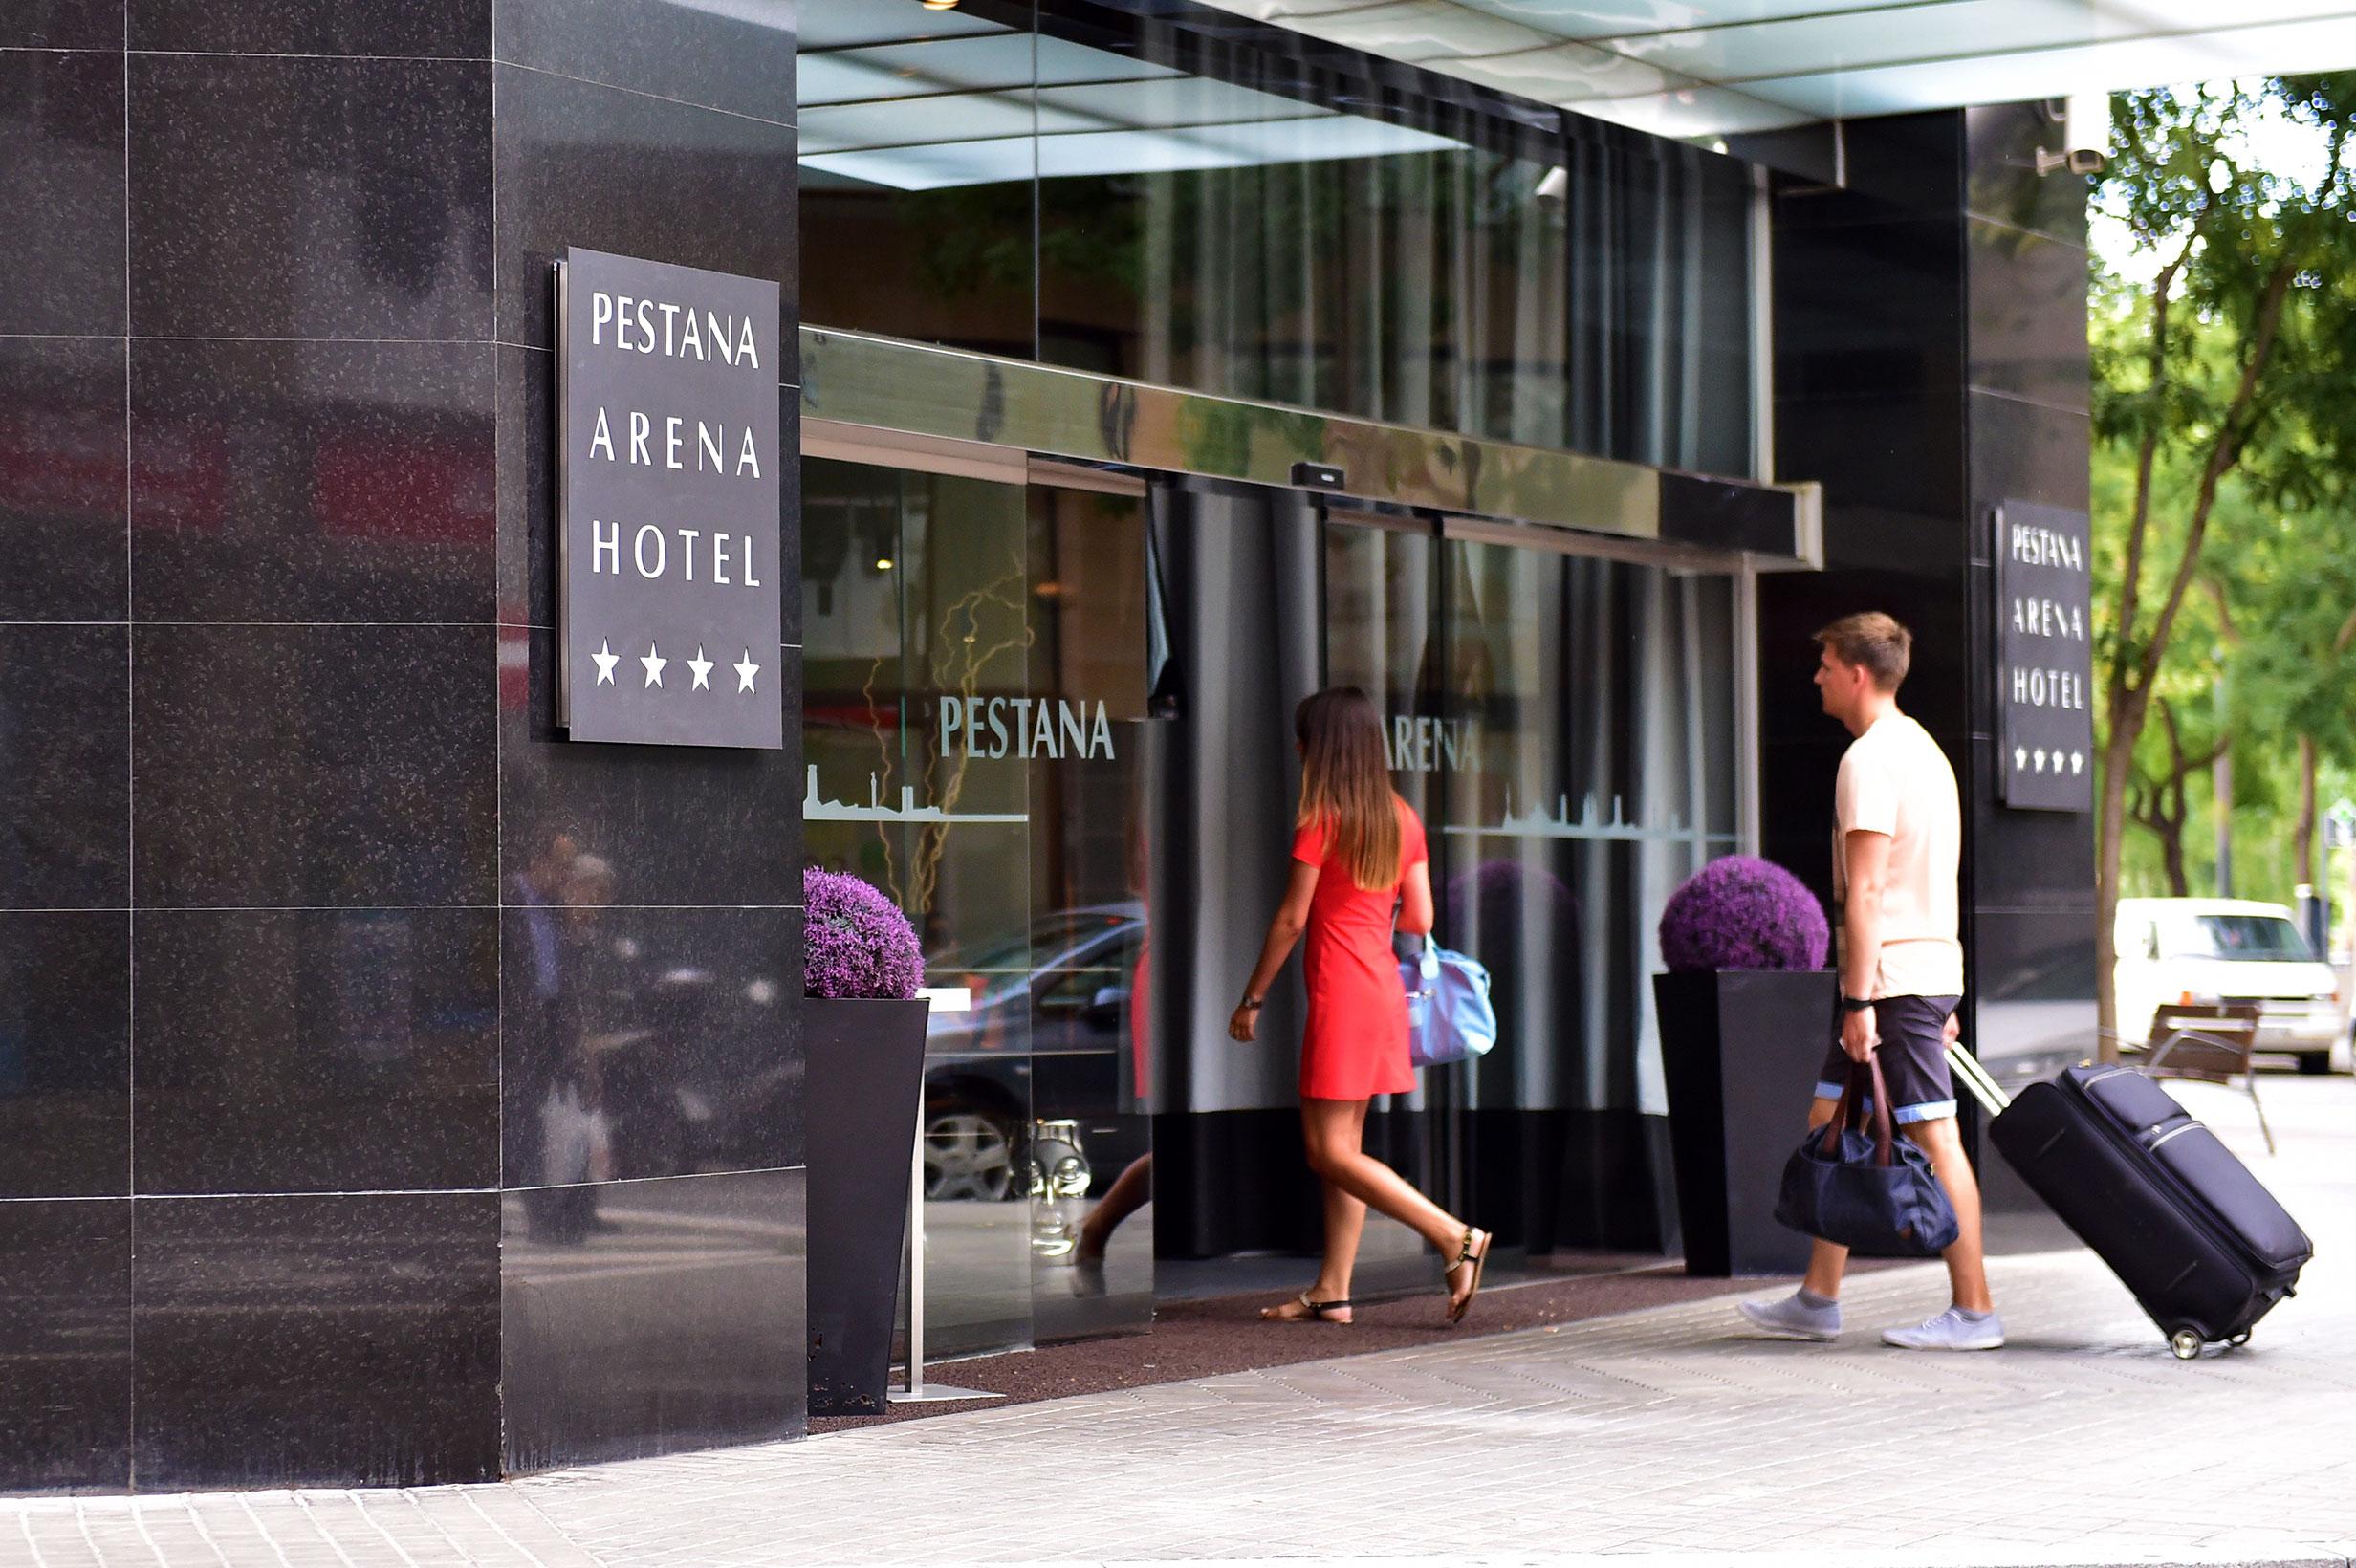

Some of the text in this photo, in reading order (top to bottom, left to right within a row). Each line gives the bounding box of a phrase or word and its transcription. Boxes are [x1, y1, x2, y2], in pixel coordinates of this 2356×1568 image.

[591, 292, 761, 370] PESTANA
[589, 406, 762, 480] ARENA
[591, 519, 761, 587] HOTEL
[2012, 523, 2083, 572] PESTANA
[2012, 597, 2084, 642] ARENA
[2012, 666, 2083, 710] HOTEL
[939, 695, 1116, 761] PESTANA
